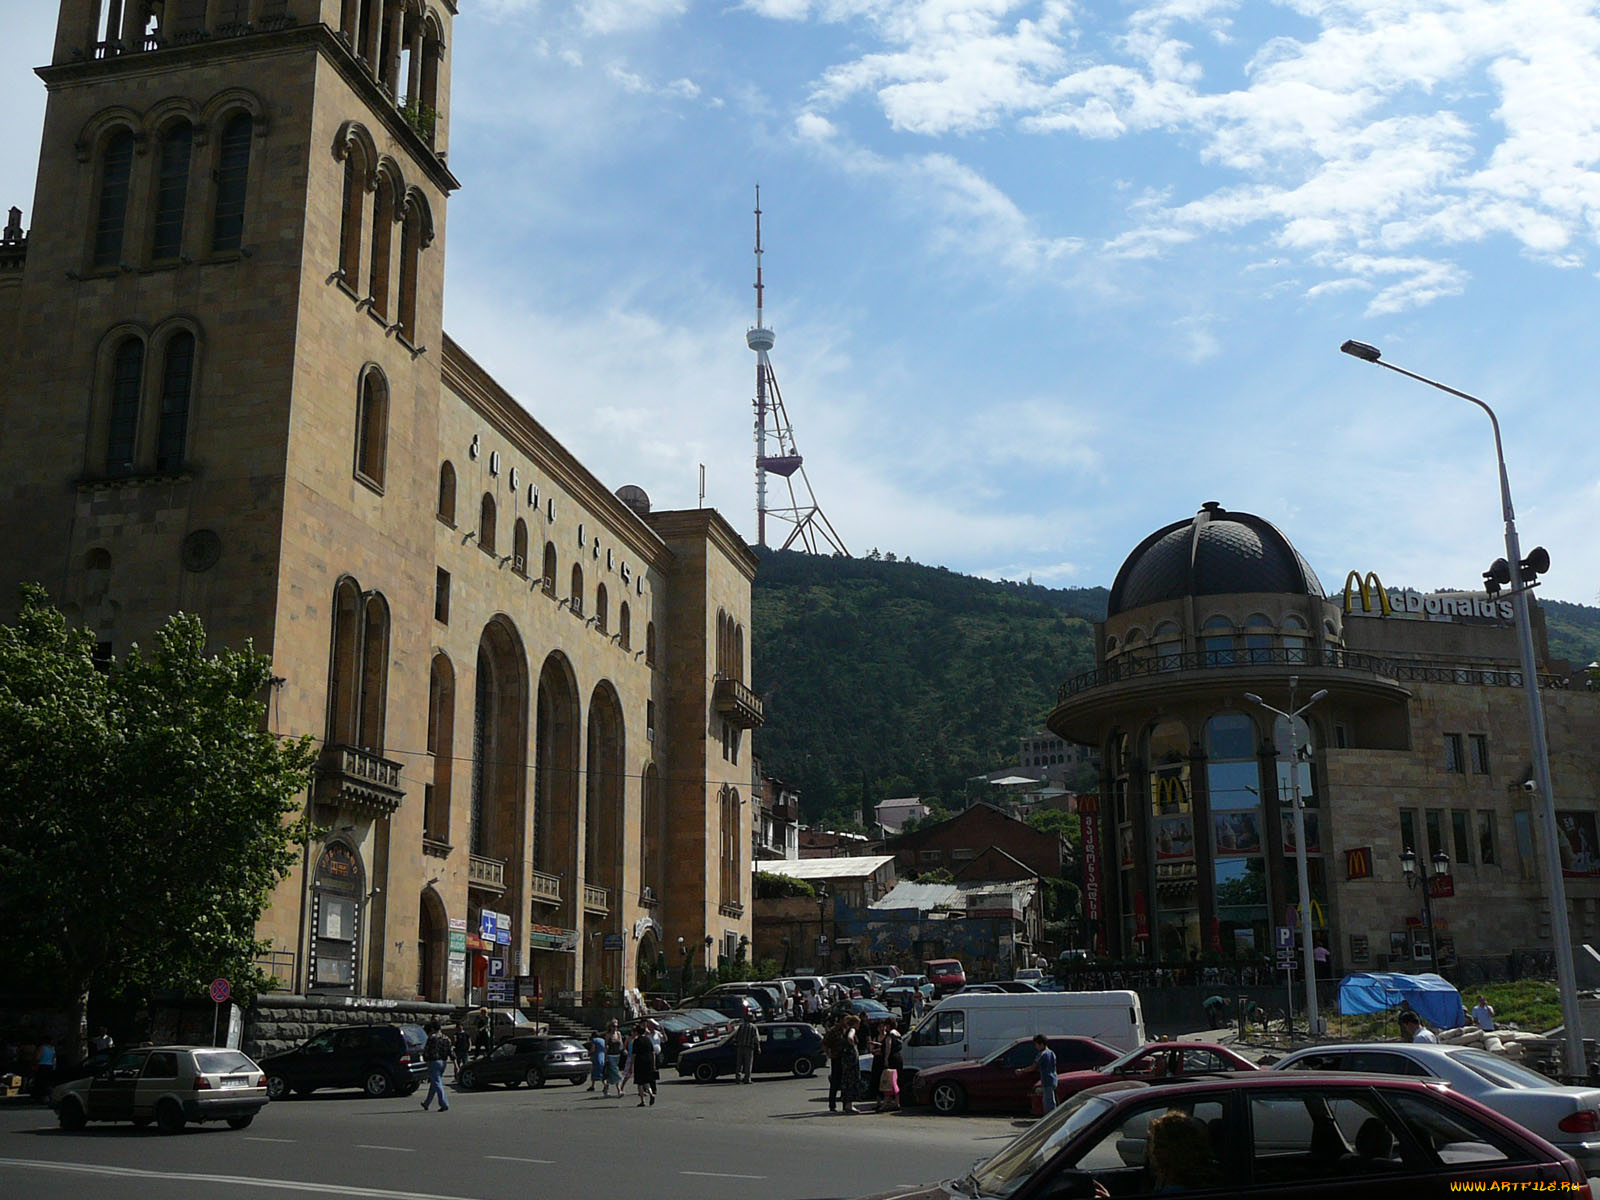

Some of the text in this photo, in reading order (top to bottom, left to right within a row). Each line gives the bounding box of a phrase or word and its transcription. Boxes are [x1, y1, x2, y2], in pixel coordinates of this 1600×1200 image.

[1344, 570, 1513, 619] McDonald's
[1280, 928, 1290, 945] P
[491, 960, 502, 976] P
